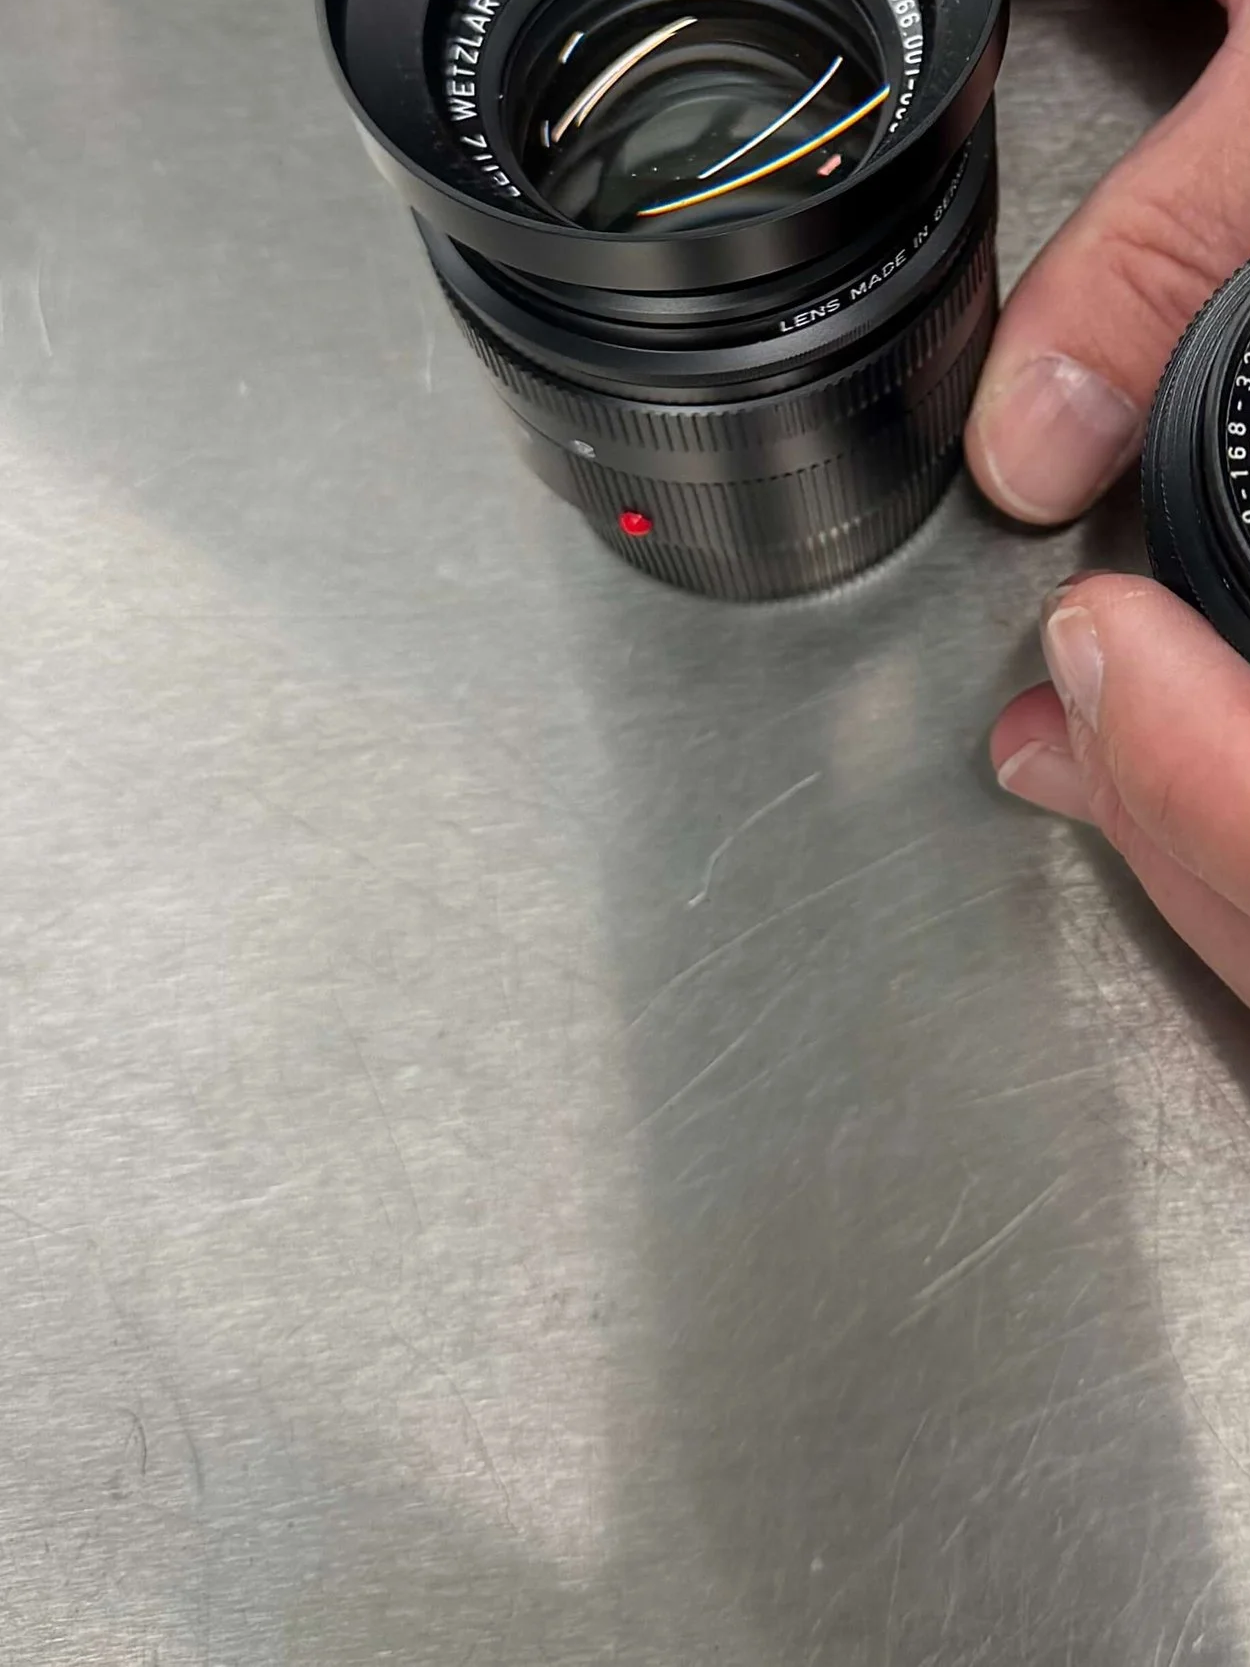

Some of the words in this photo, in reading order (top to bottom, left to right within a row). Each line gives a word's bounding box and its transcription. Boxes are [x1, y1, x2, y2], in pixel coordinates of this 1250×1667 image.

[780, 297, 841, 332] LENS
[849, 248, 907, 300] MADE
[912, 224, 929, 249] IN
